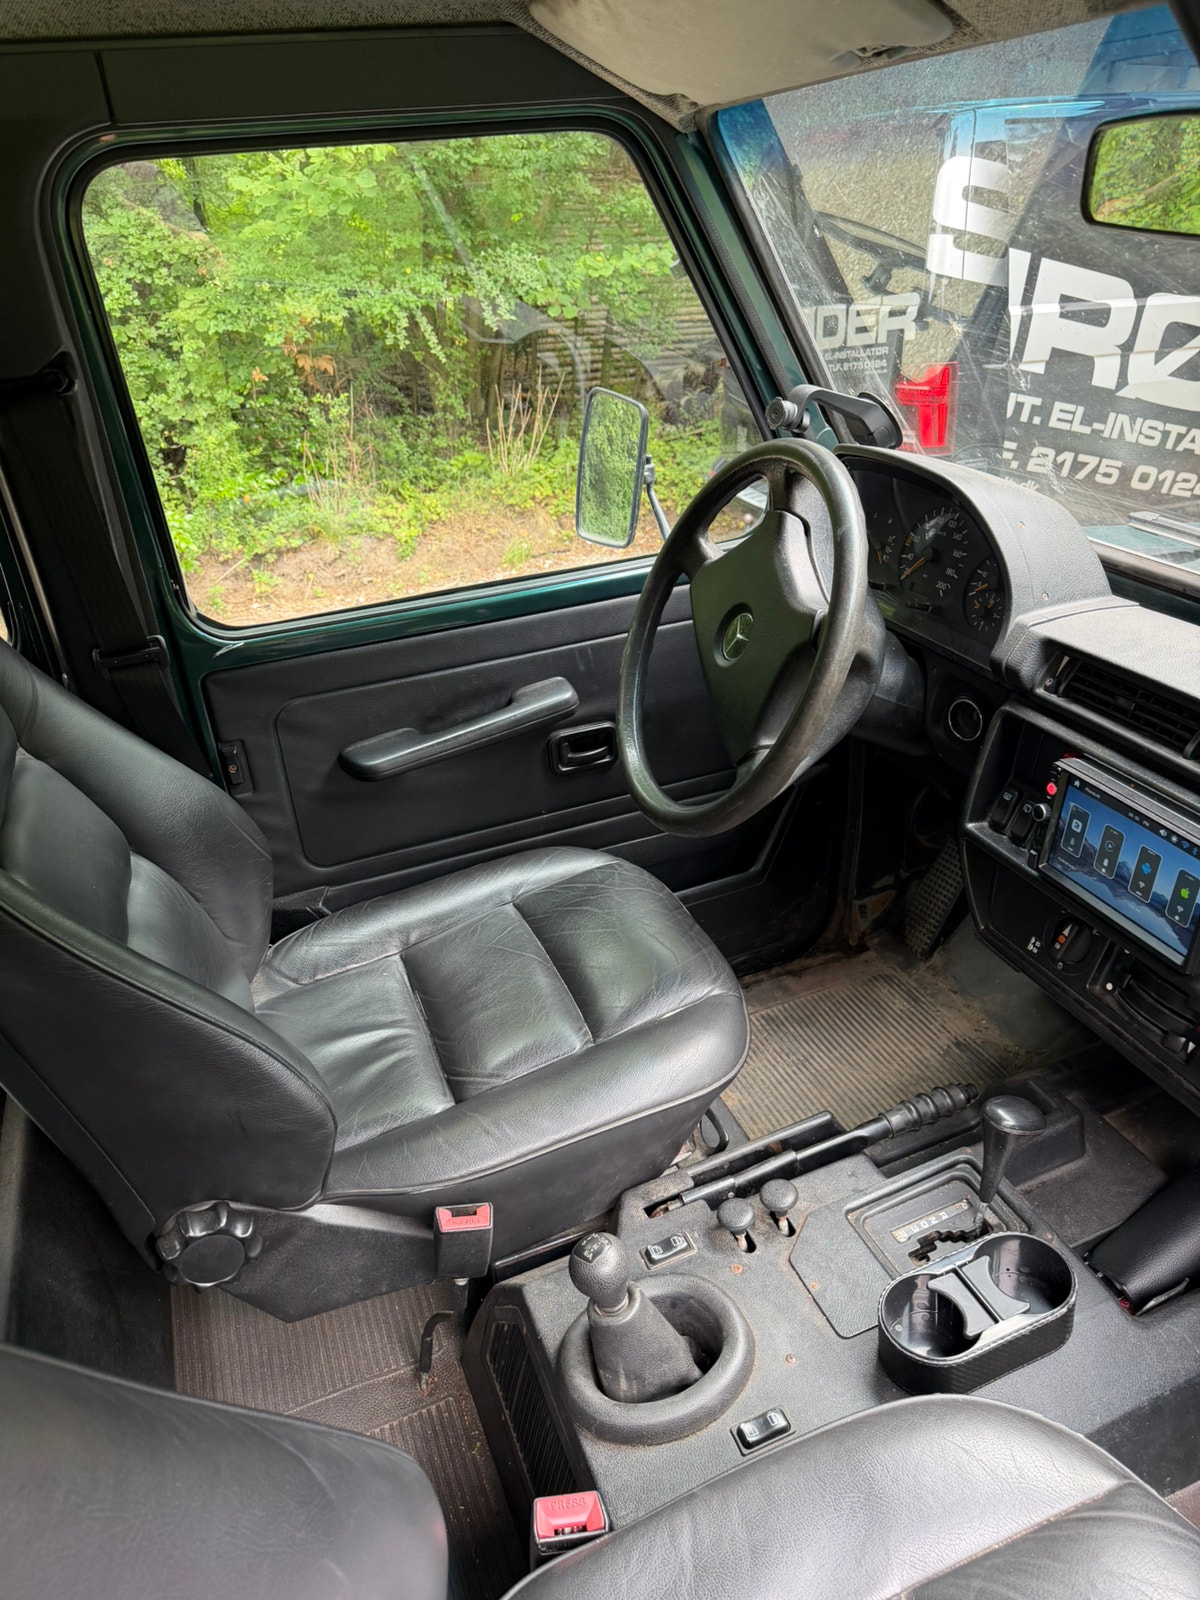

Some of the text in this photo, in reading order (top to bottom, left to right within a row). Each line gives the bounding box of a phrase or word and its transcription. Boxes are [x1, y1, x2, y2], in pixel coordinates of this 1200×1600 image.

[807, 292, 921, 350] DER
[843, 361, 863, 372] 2175
[1026, 446, 1123, 485] 2175
[1130, 464, 1200, 498] 012
[936, 580, 947, 590] 200
[549, 1497, 586, 1511] PRESS
